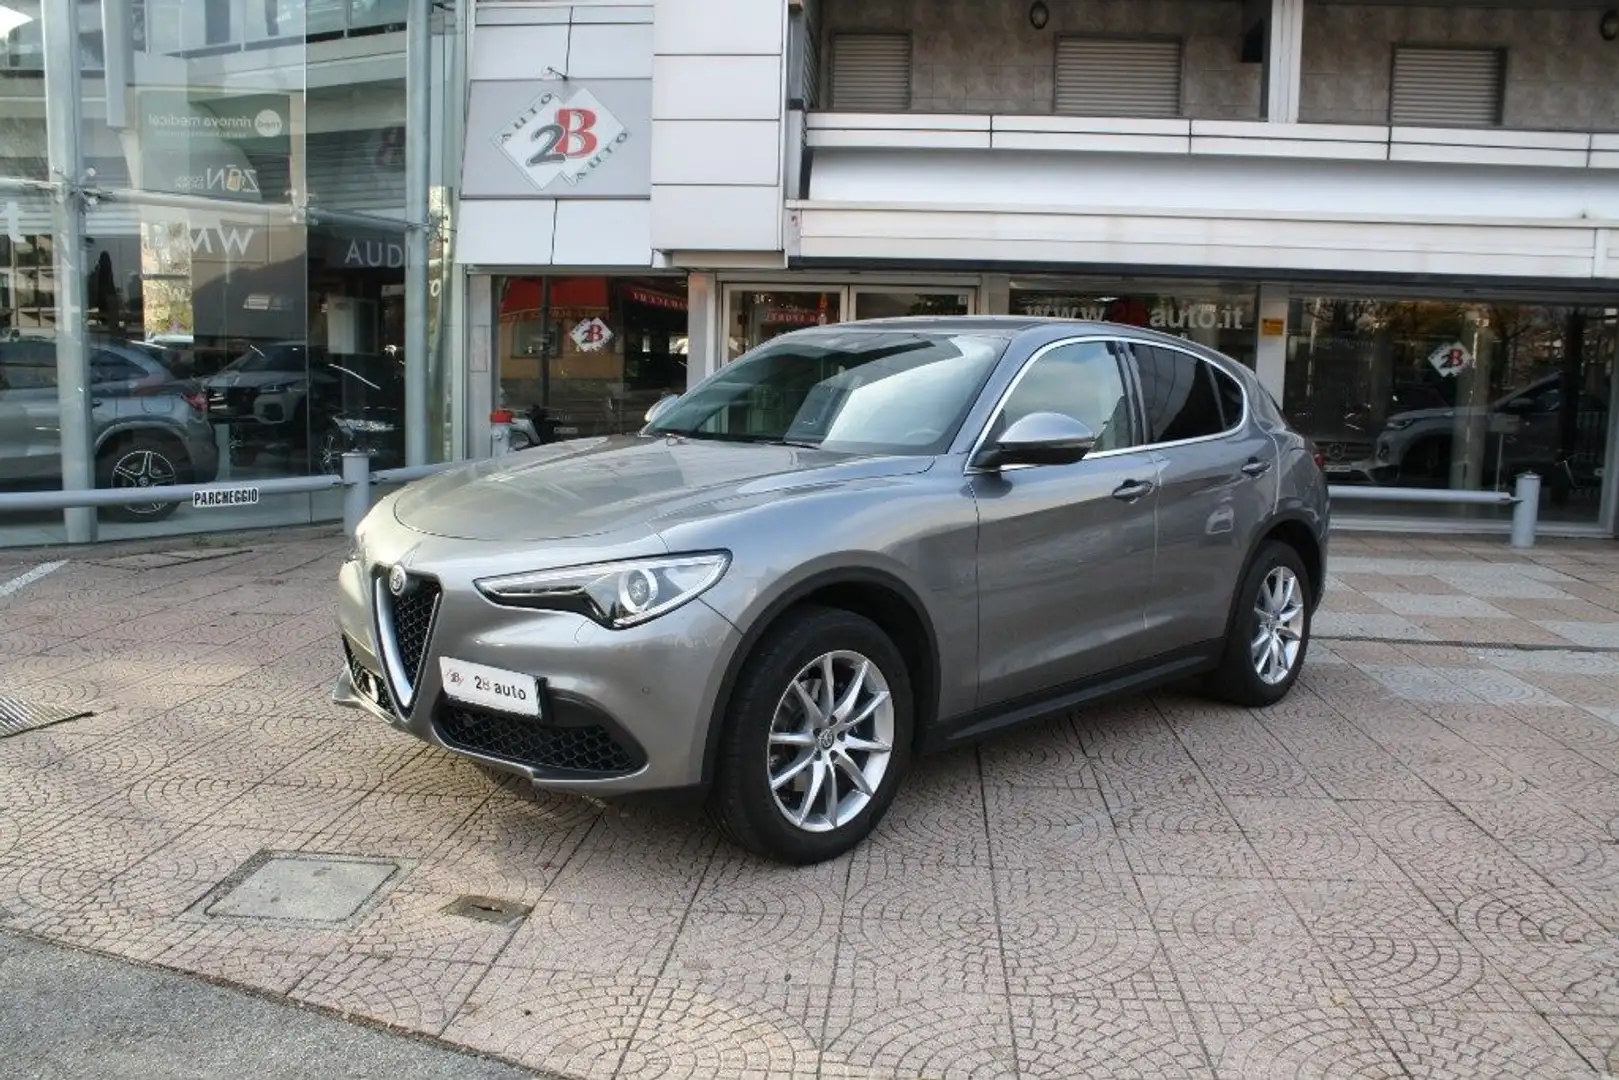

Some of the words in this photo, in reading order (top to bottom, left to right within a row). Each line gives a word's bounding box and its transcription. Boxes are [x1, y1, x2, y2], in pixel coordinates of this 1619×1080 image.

[501, 93, 552, 143] AUTO
[526, 109, 597, 167] 2B
[576, 132, 628, 182] AUTO
[344, 237, 407, 268] AUD
[194, 488, 258, 505] PARCHEGGIO
[494, 683, 526, 700] auto
